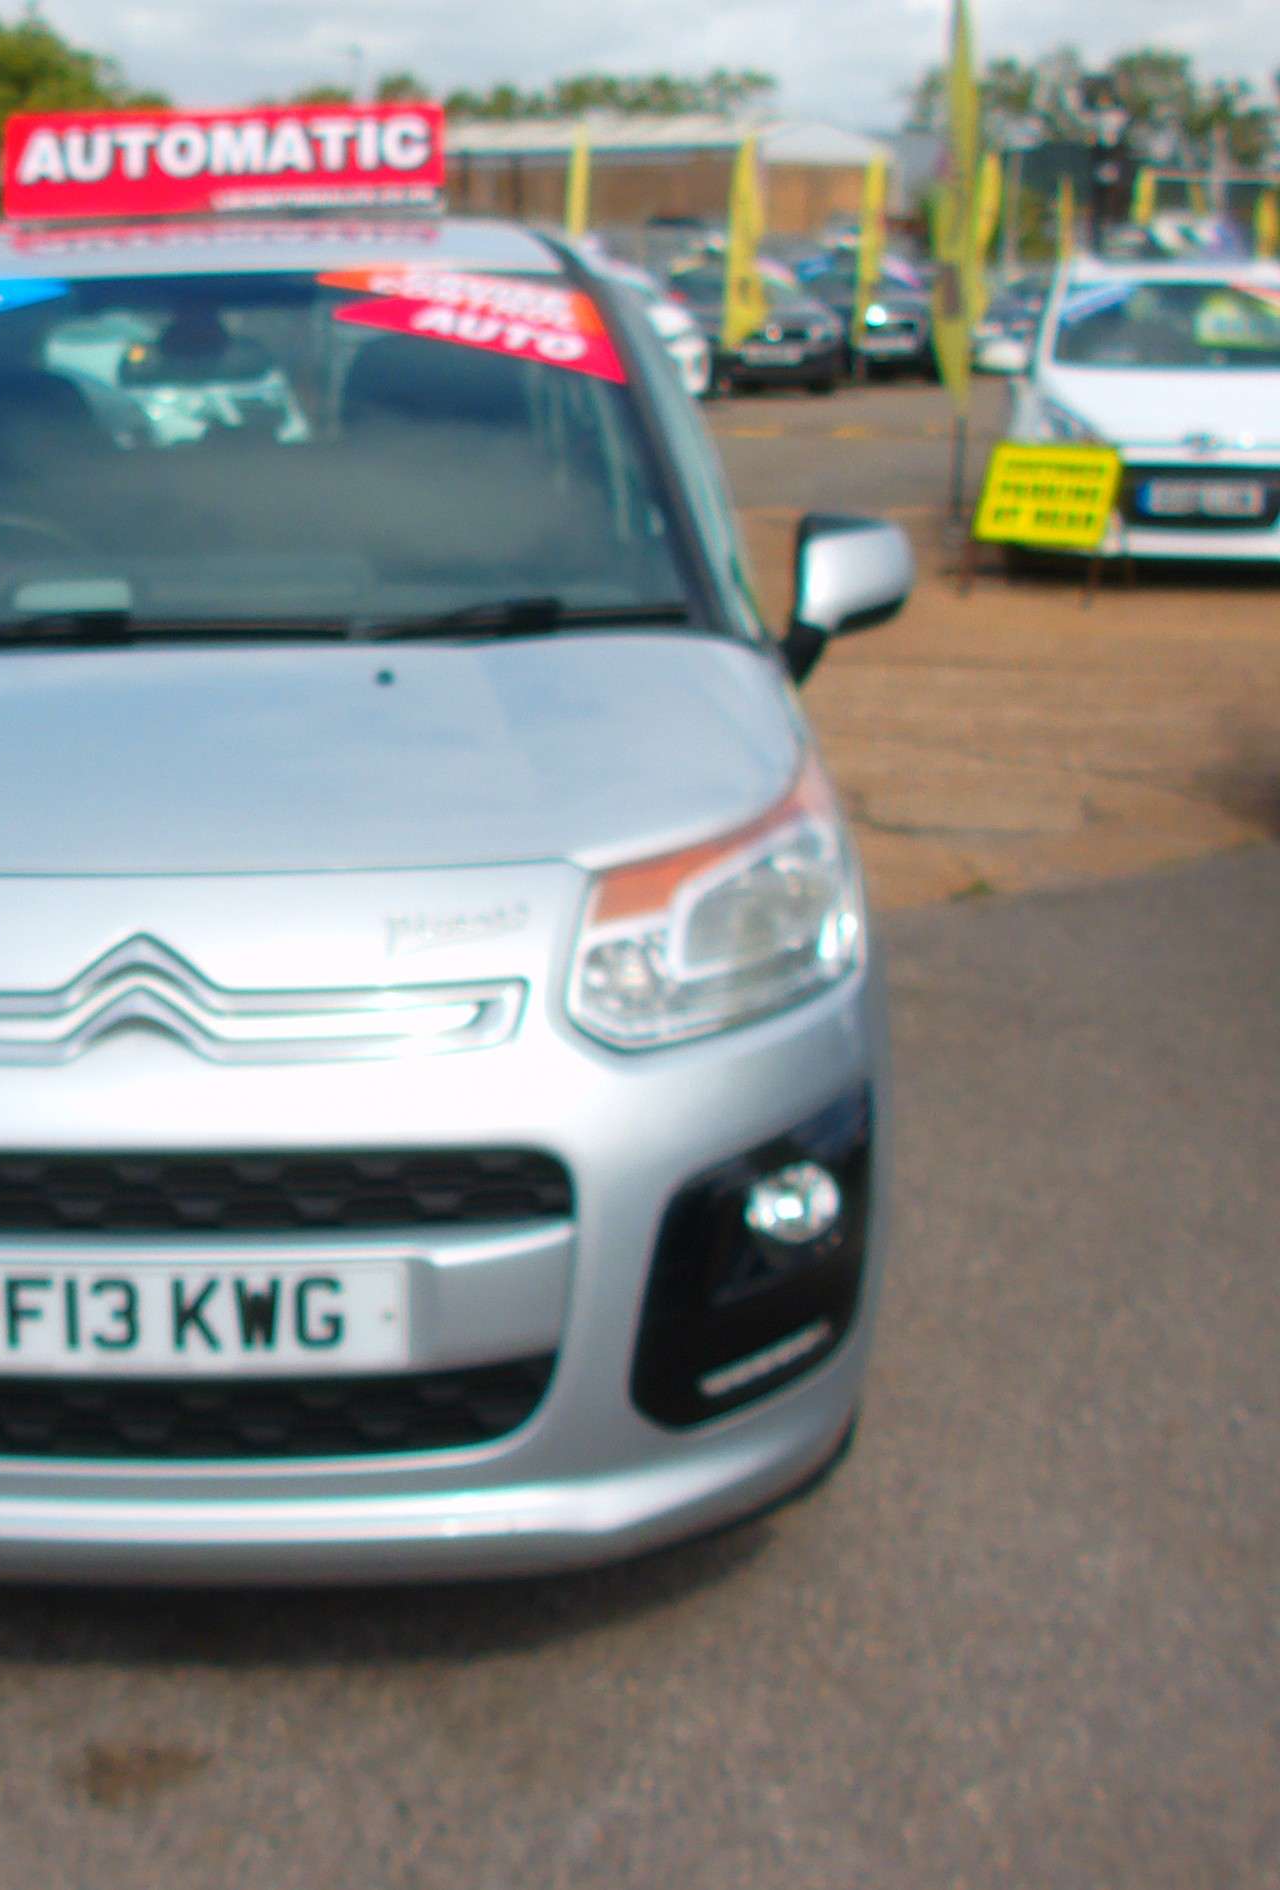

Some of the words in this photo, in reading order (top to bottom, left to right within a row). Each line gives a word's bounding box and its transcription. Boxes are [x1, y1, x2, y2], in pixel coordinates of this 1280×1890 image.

[16, 114, 431, 186] AUTOMATIC
[410, 304, 587, 361] AUTO
[169, 1275, 345, 1351] KWG
